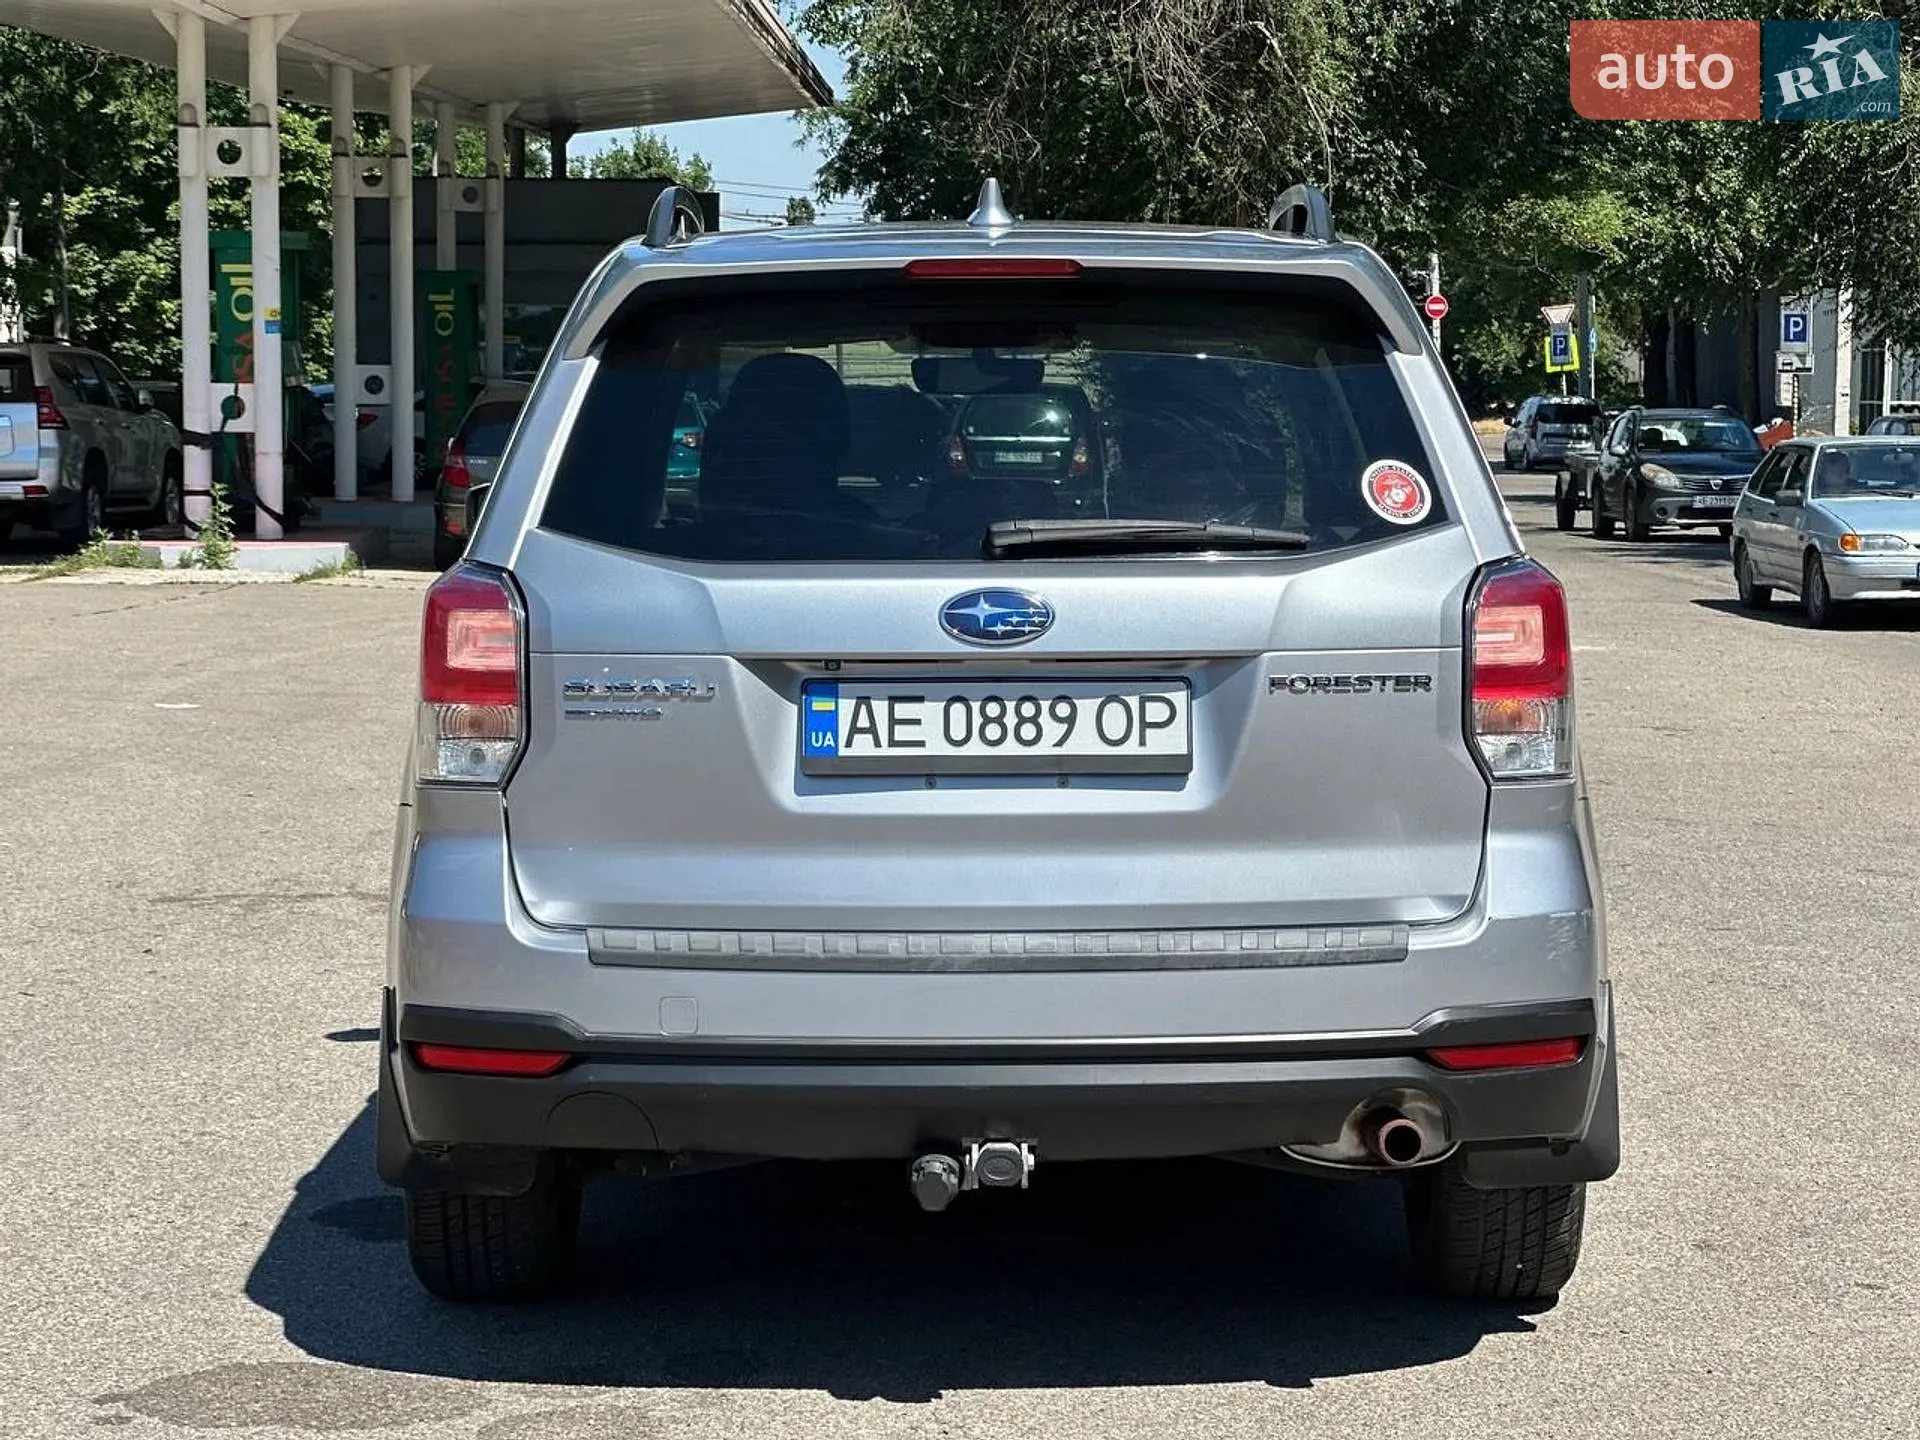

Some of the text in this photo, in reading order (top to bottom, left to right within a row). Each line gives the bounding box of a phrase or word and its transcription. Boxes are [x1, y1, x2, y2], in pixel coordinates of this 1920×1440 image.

[428, 289, 455, 337] OIL
[1790, 316, 1803, 340] P
[1556, 337, 1566, 354] P
[1268, 674, 1432, 695] FORESTER
[844, 694, 1177, 748] AE 0889 OP
[811, 731, 835, 748] UA
